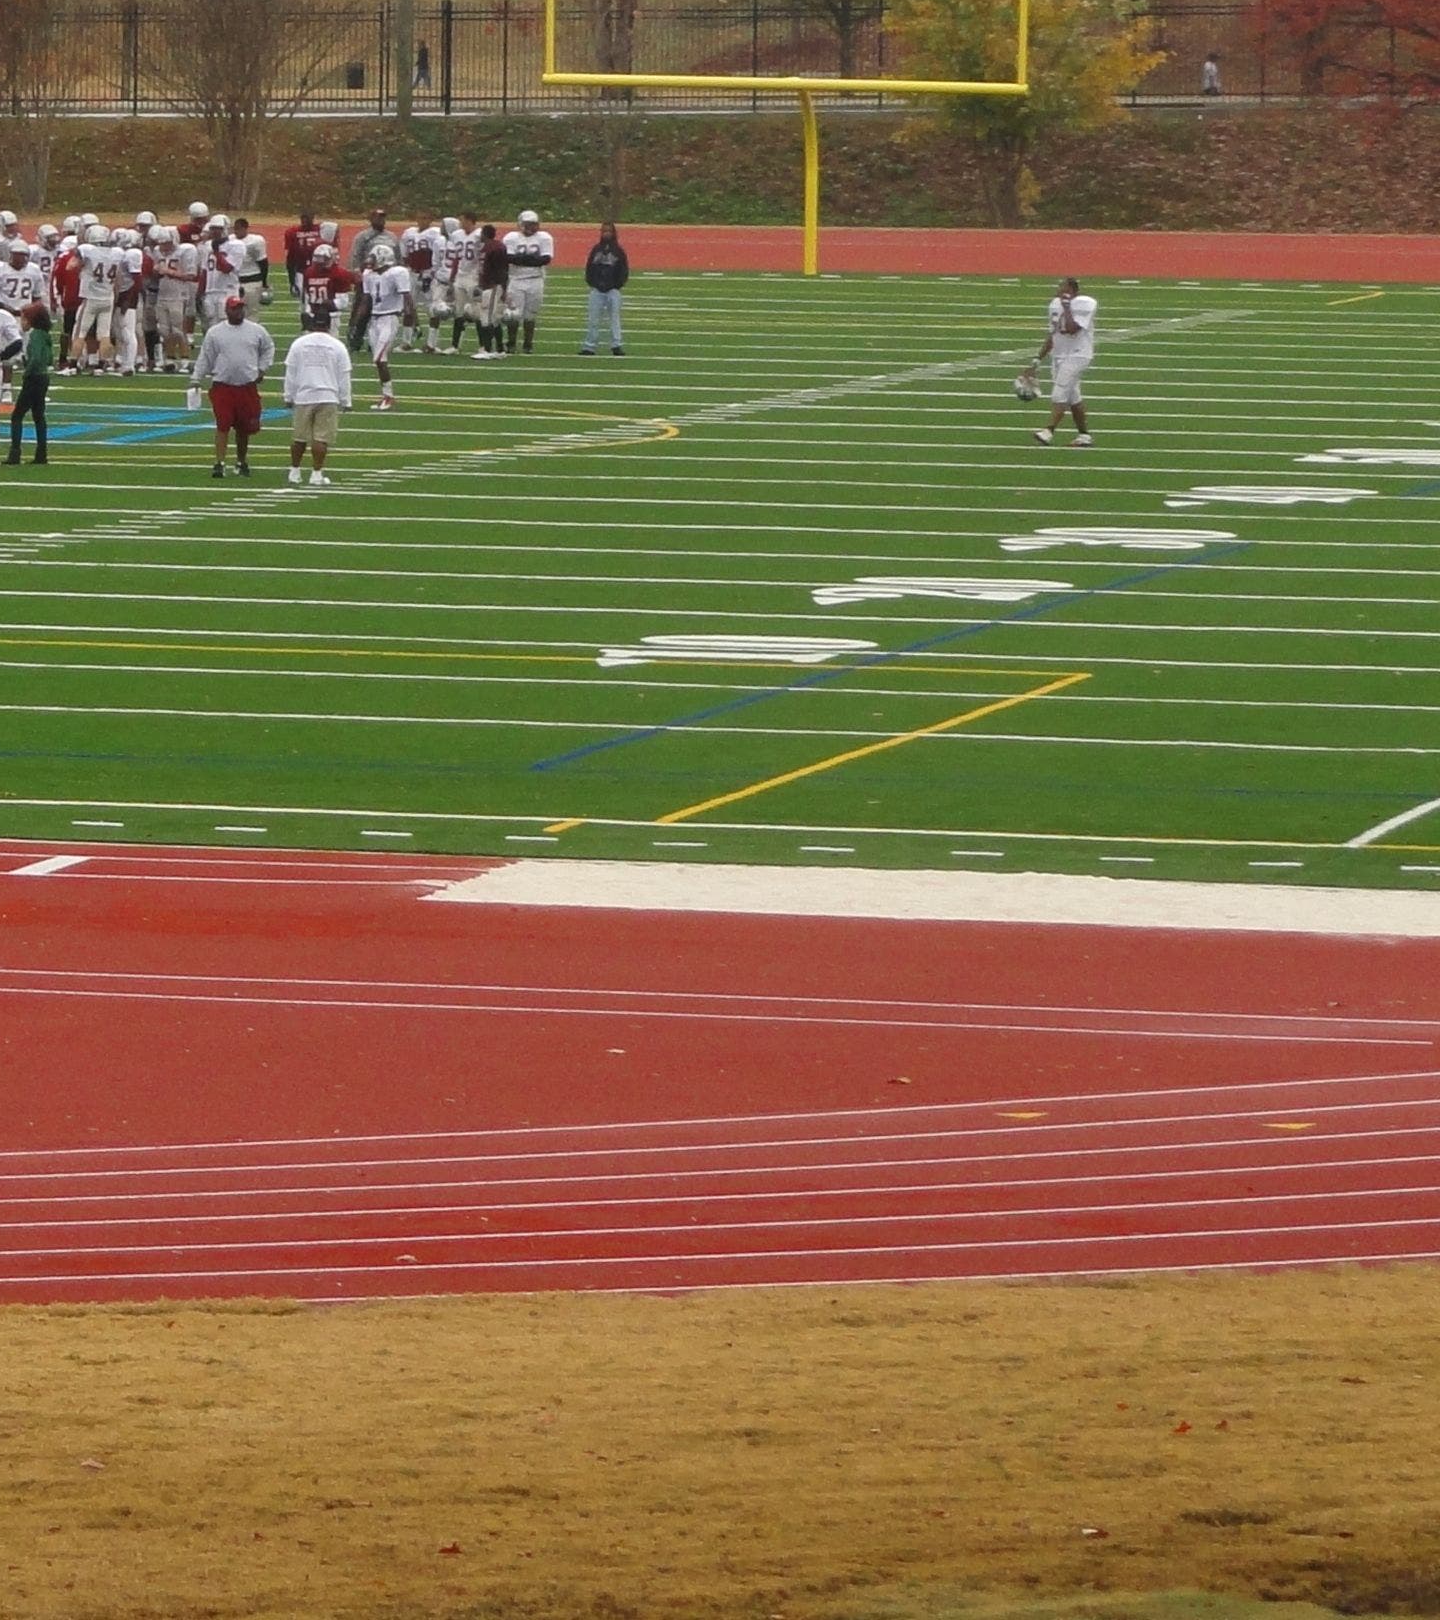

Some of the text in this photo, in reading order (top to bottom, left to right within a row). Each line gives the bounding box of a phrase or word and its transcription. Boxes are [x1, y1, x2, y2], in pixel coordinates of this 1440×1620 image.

[93, 262, 117, 283] 44
[6, 278, 32, 300] 72
[598, 634, 879, 664] 10
